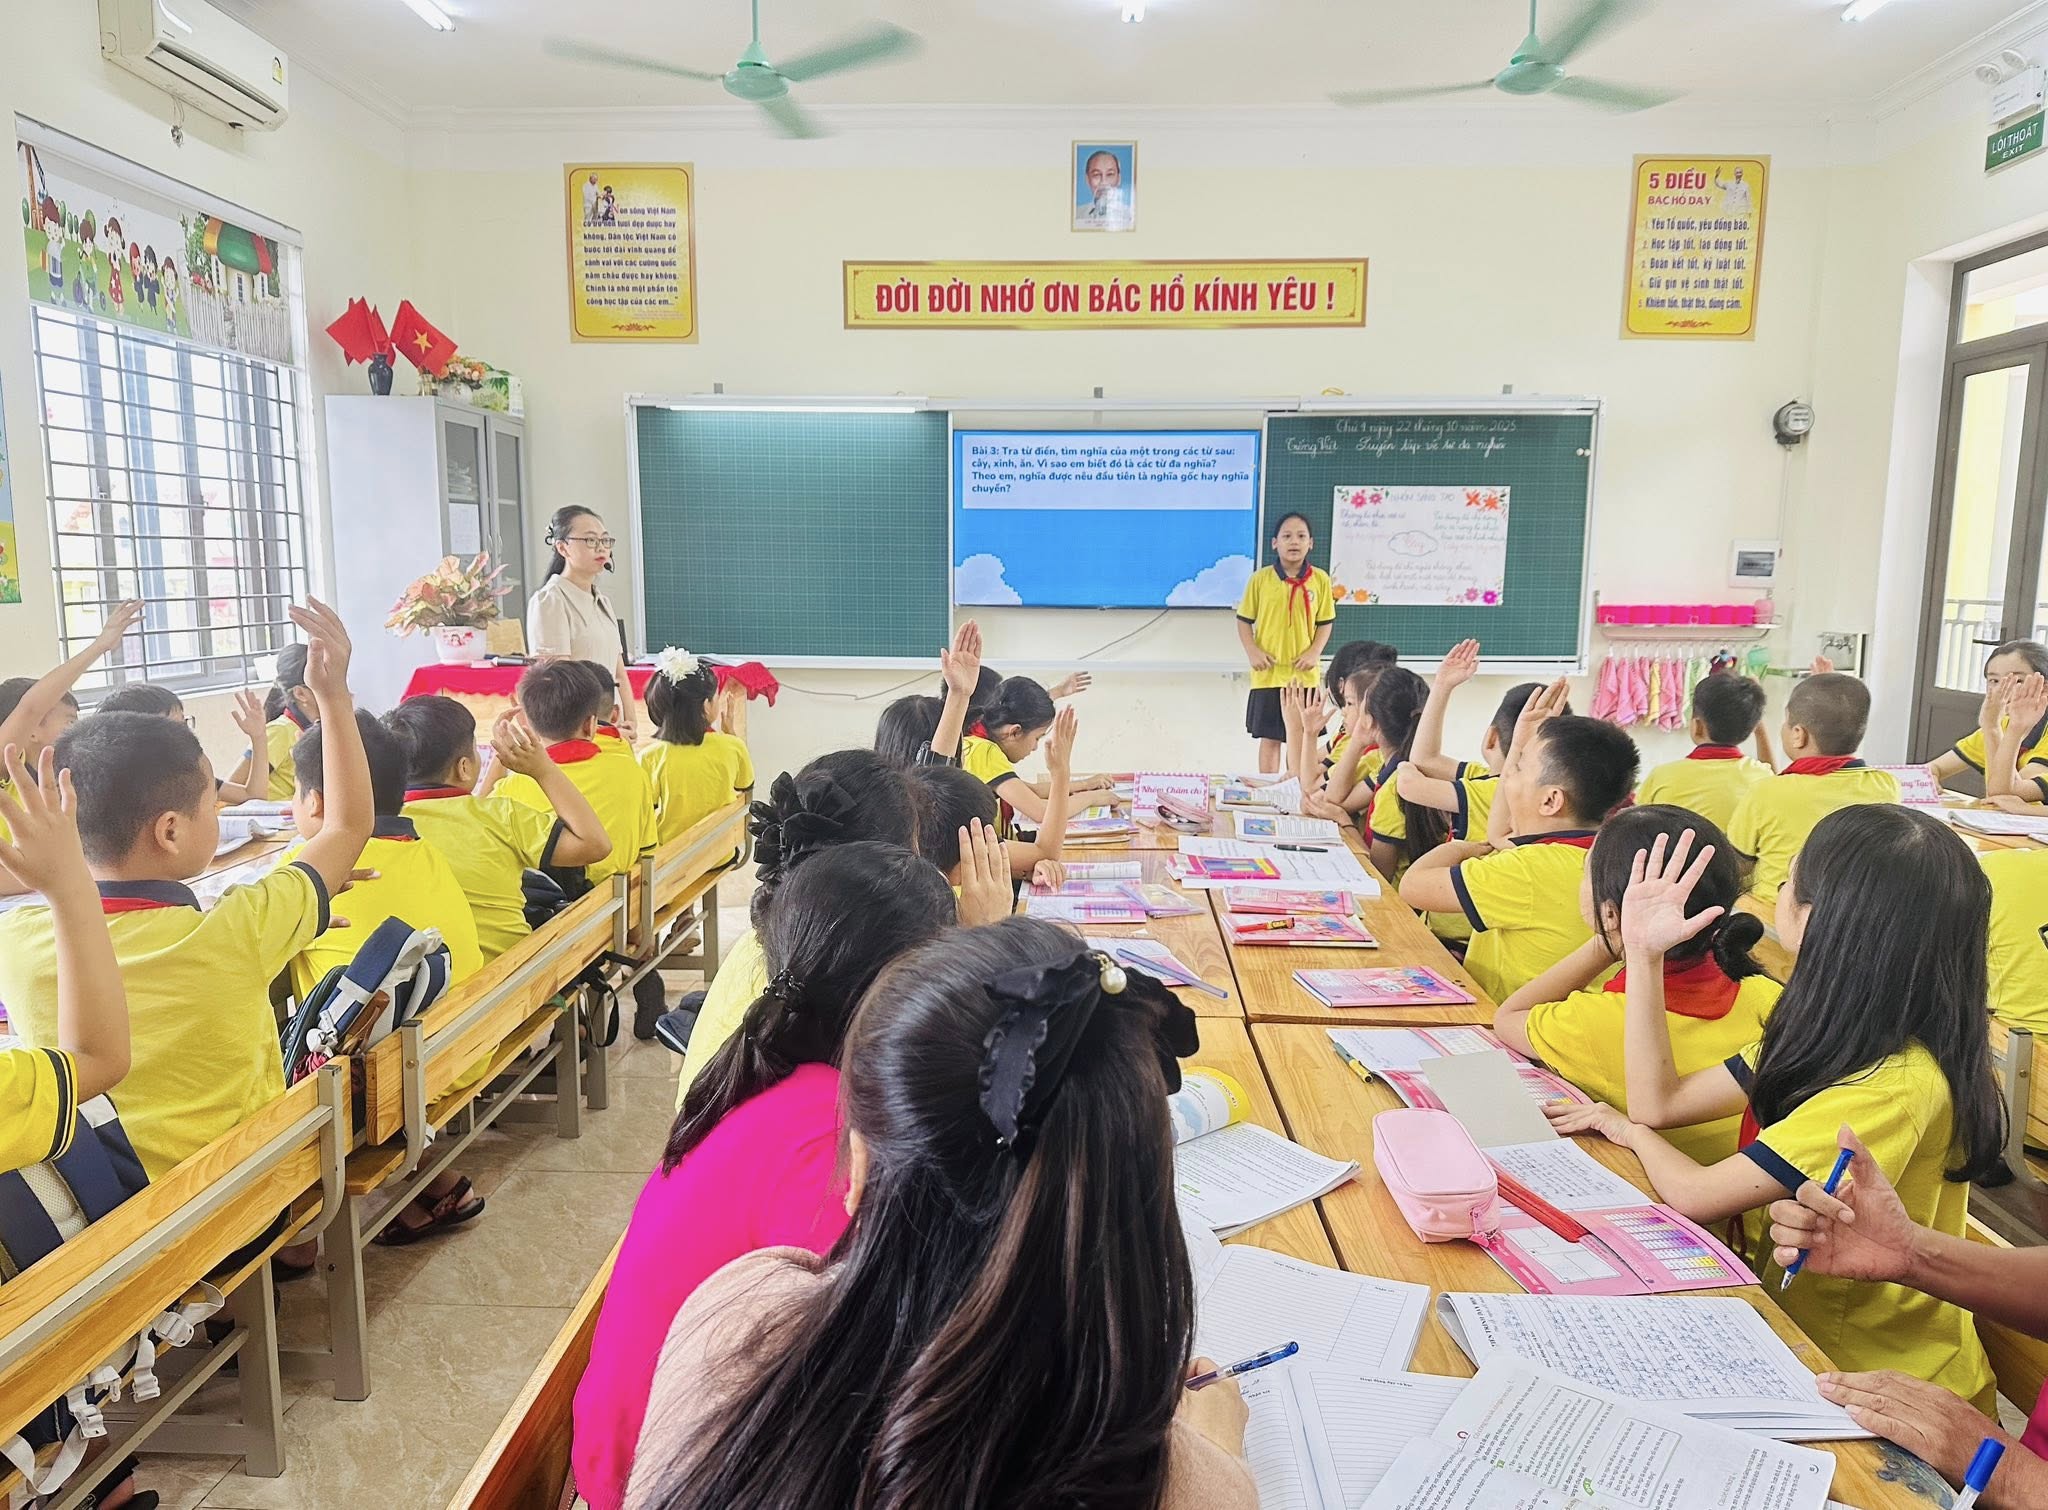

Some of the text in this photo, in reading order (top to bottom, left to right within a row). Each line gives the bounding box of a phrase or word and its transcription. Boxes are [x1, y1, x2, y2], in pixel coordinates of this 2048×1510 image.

[2002, 144, 2025, 159] EXIT
[1649, 173, 1660, 189] 5
[664, 220, 676, 229] hay
[644, 246, 666, 254] quang
[640, 272, 653, 280] hay
[875, 273, 1335, 313] ĐỜI ĐỜI NHỚ ƠN BÁC HỒ KÍNH YÊU !
[1395, 420, 1412, 432] 22
[971, 446, 988, 455] Bài
[989, 446, 1000, 455] 3:
[1002, 447, 1019, 455] Tra
[1021, 446, 1033, 455] từ
[1061, 446, 1078, 455] tìm
[1080, 446, 1108, 457] nghĩa
[1110, 446, 1127, 455] của
[1130, 447, 1150, 457] một
[1152, 447, 1180, 457] trong
[1182, 446, 1199, 455] các
[1201, 446, 1213, 455] từ
[993, 459, 1017, 469] xinh,
[1019, 459, 1035, 468] ăn.
[1036, 459, 1048, 468] Vì
[1087, 458, 1107, 468] biết
[1109, 459, 1122, 468] đó
[1124, 459, 1134, 468] là
[1136, 459, 1153, 468] các
[1155, 459, 1167, 468] từ
[1168, 459, 1181, 468] đa
[1184, 459, 1217, 470] nghĩa?
[971, 472, 996, 480] Theo
[998, 473, 1017, 481] em,
[1019, 472, 1046, 482] nghĩa
[1048, 472, 1072, 483] được
[1074, 472, 1093, 480] nêu
[1116, 471, 1136, 480] tiên
[1138, 472, 1148, 480] là
[1150, 472, 1178, 482] nghĩa
[1180, 471, 1199, 482] gốc
[1201, 472, 1219, 482] hay
[1221, 472, 1249, 482] nghĩa
[971, 483, 1011, 494] chuyển?
